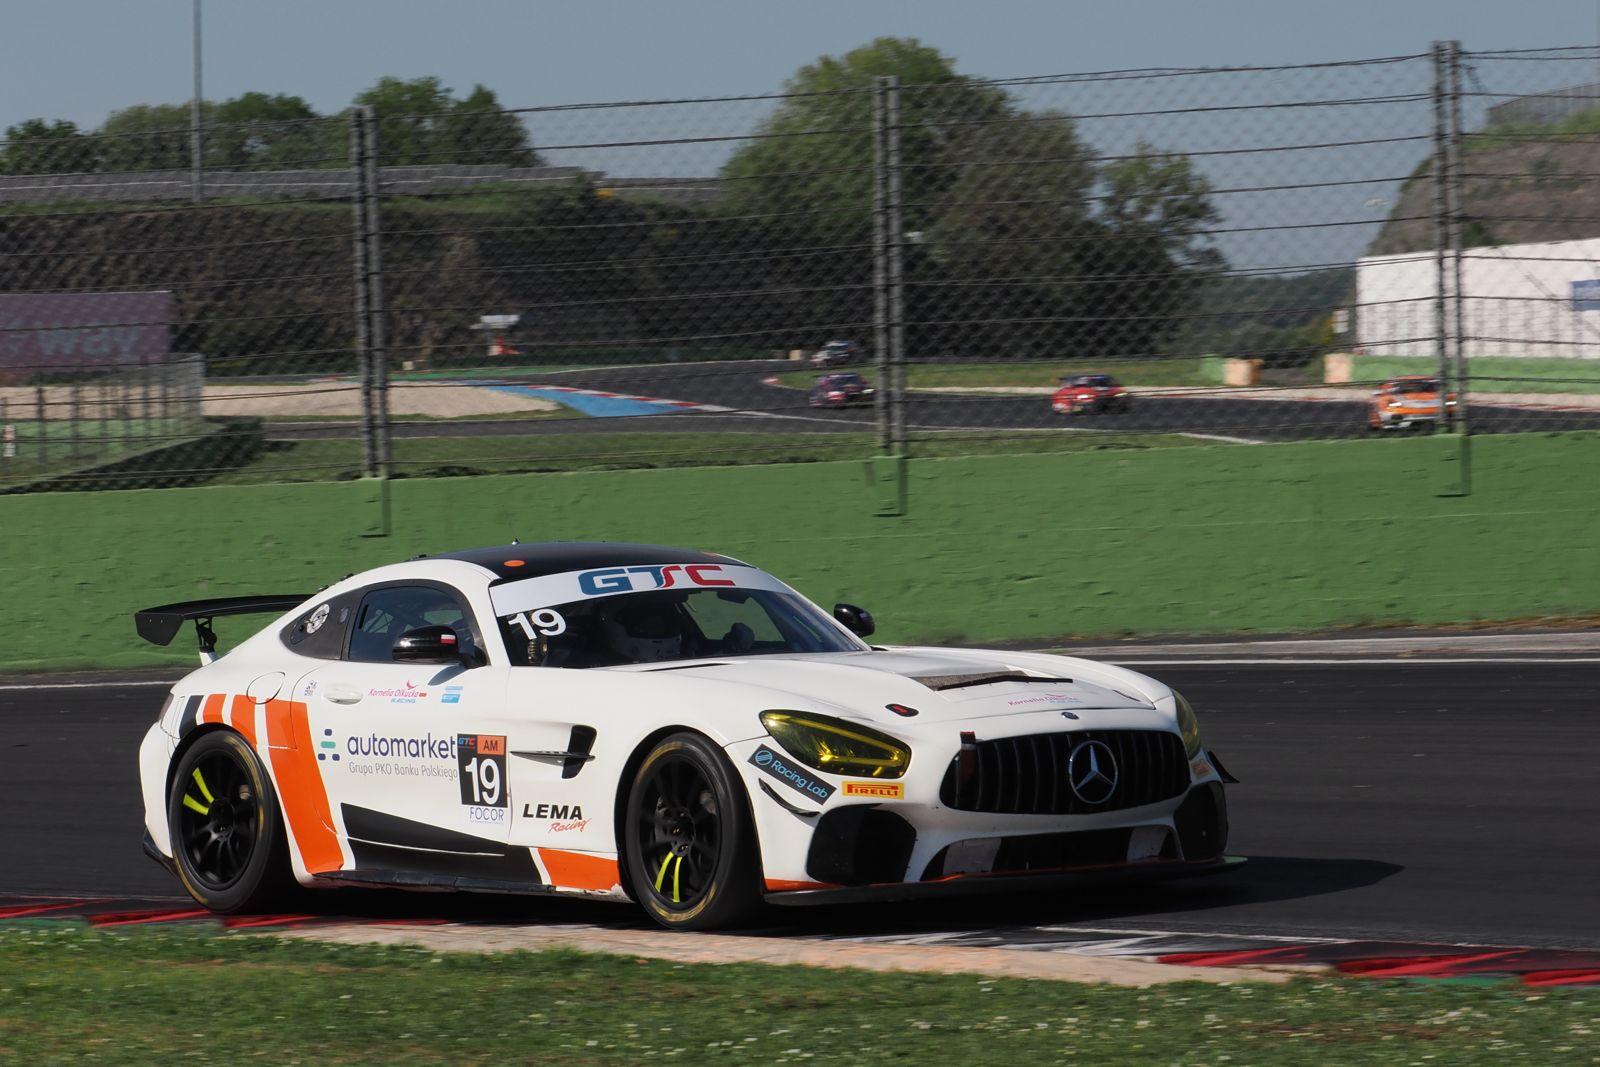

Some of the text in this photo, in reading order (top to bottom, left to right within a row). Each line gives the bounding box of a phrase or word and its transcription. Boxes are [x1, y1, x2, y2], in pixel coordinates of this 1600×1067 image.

[508, 608, 567, 640] 19
[347, 732, 457, 759] automarket
[483, 740, 498, 751] AM
[349, 762, 458, 781] Grupa PKO Banku Polskiego
[771, 759, 828, 799] Racing Lab
[465, 757, 500, 805] 19
[847, 784, 899, 797] PIRELLI
[469, 807, 504, 822] FOCOR
[522, 803, 583, 820] LEMA
[548, 818, 591, 833] Racing
